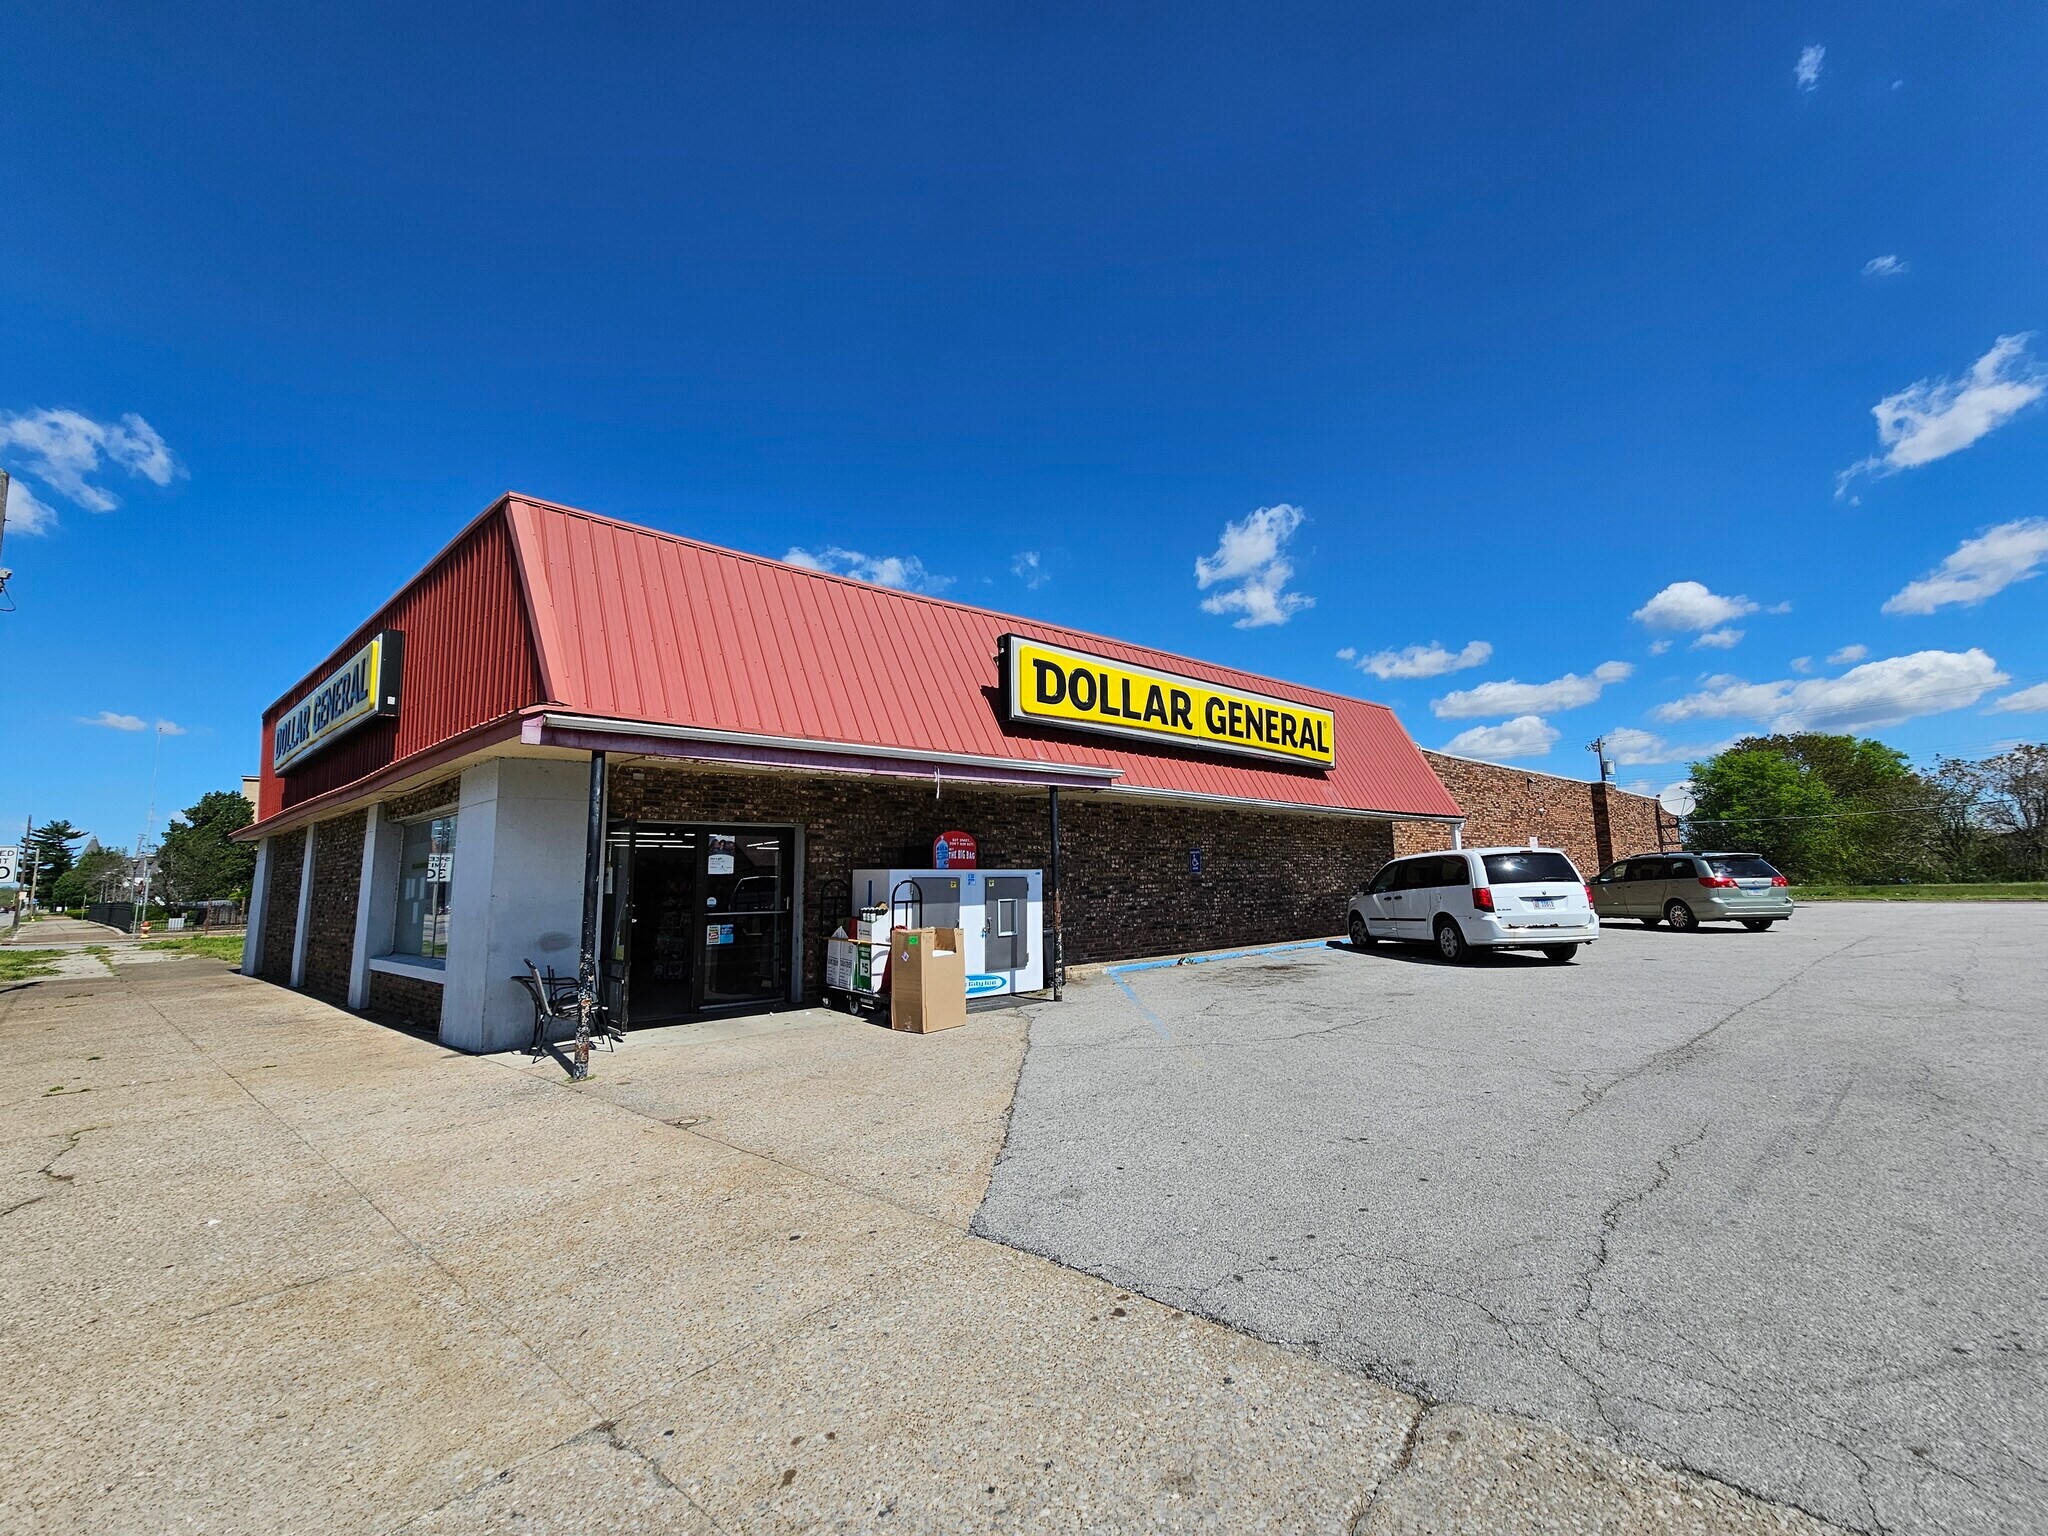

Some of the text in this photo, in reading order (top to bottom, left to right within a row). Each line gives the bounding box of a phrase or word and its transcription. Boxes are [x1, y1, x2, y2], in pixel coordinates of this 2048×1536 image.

[275, 657, 369, 761] DOLLAR GENERAL
[1032, 657, 1330, 754] DOLLAR GENERAL
[949, 850, 976, 860] THE BIG BAG
